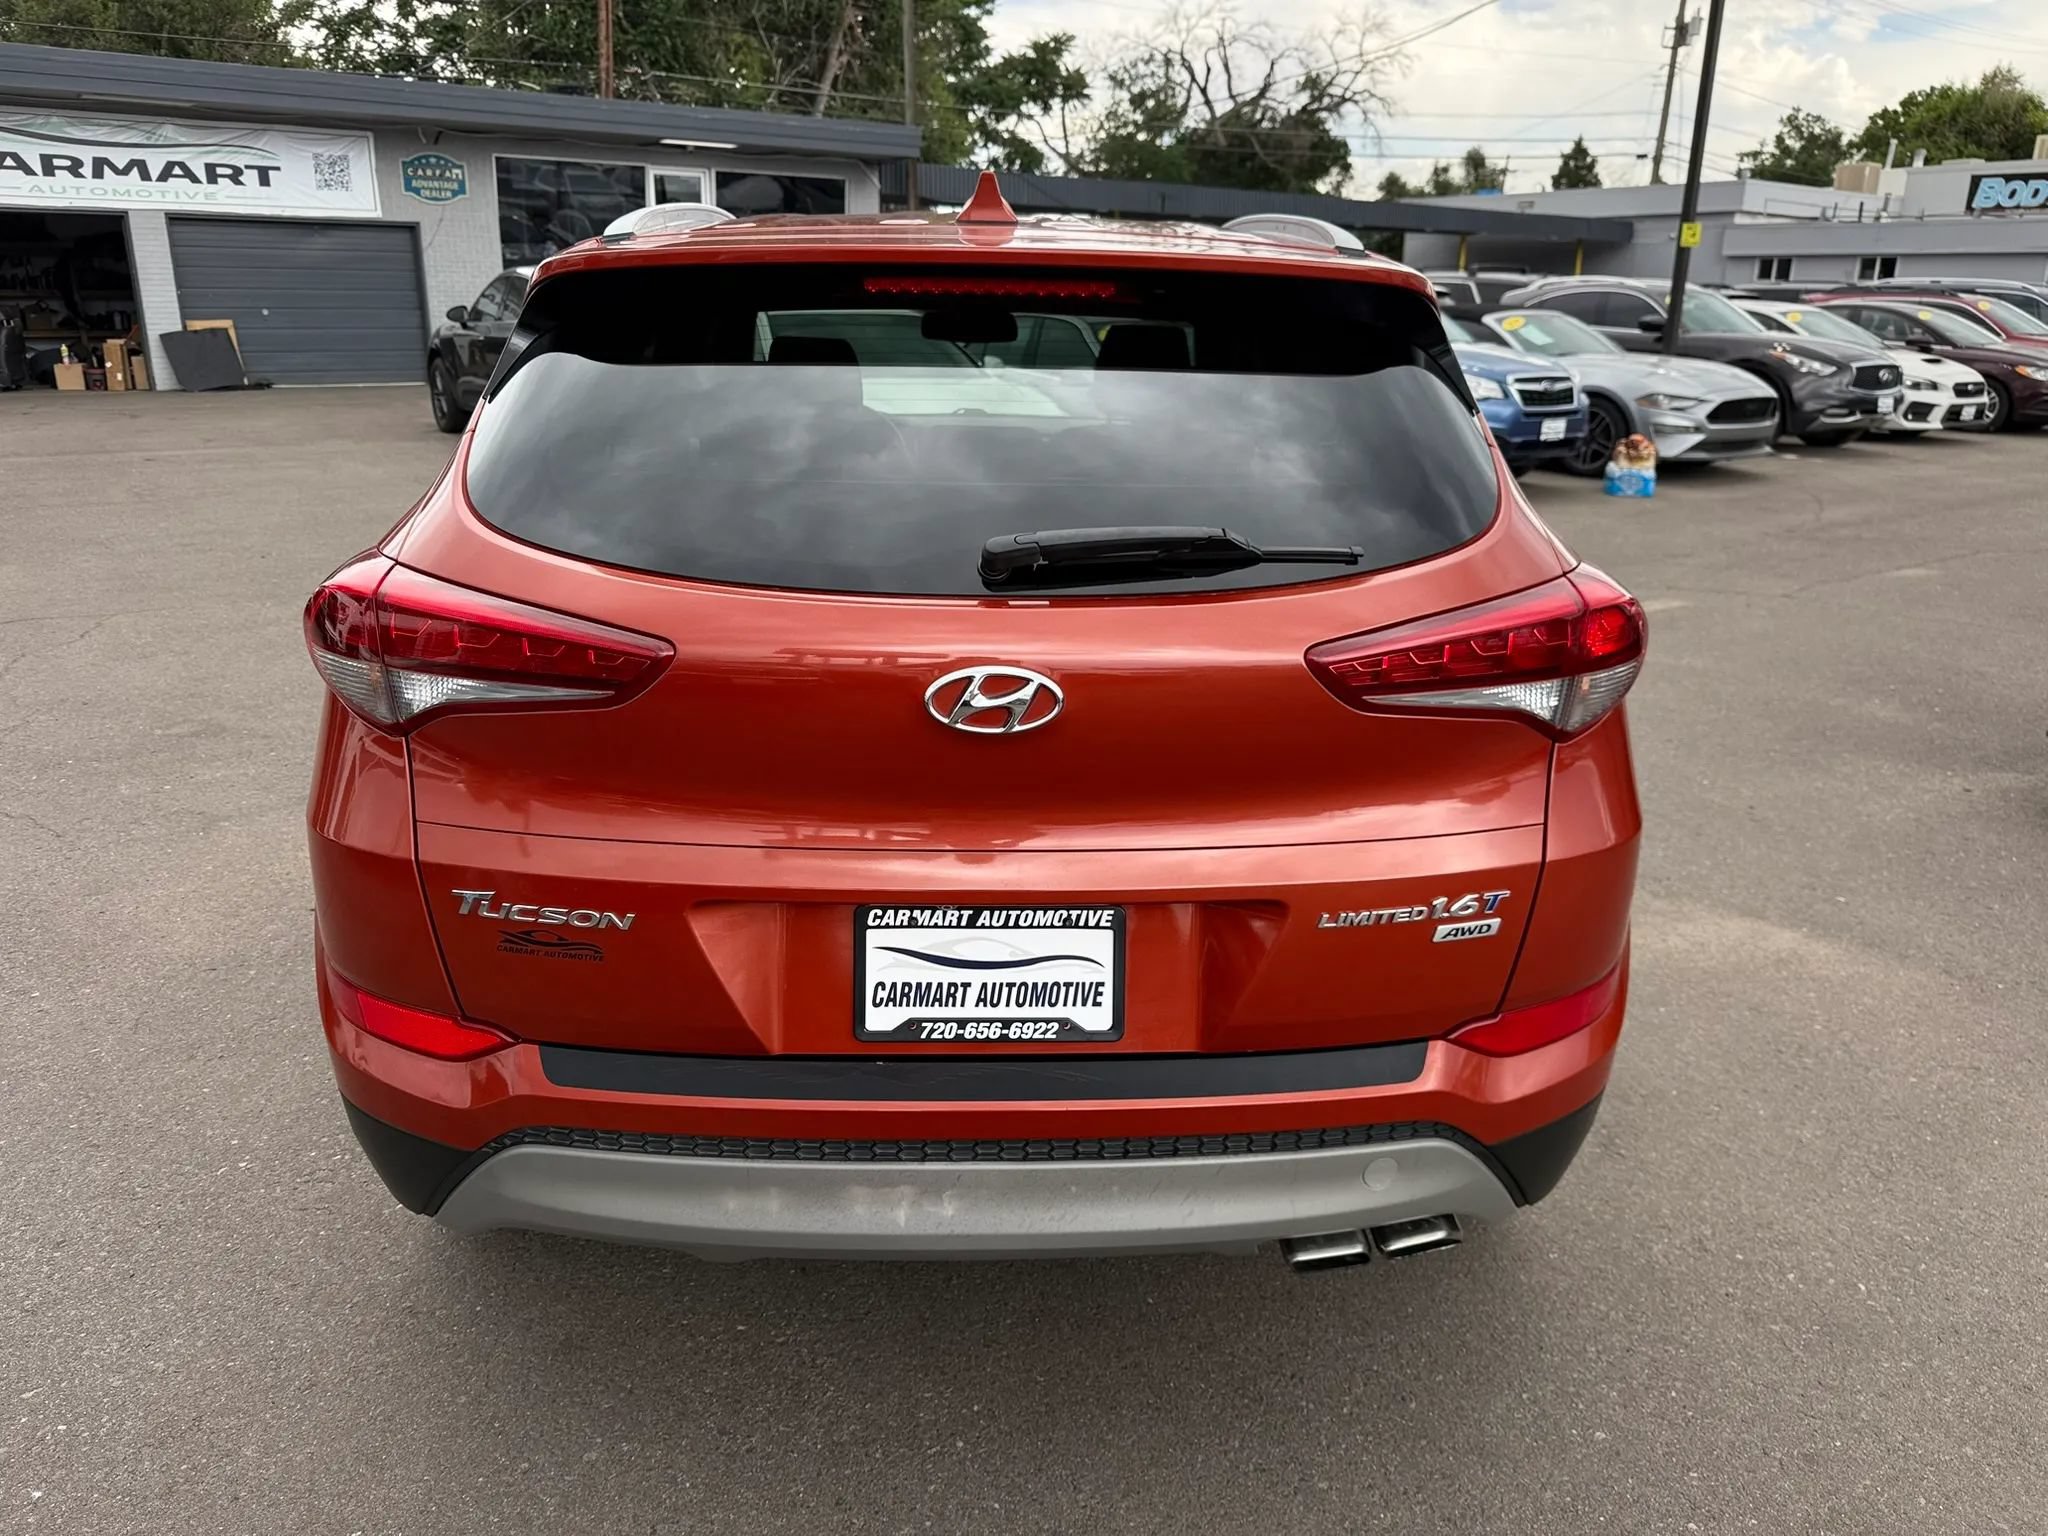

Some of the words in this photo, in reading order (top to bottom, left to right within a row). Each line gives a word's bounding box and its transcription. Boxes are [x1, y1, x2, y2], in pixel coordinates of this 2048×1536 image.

[0, 151, 281, 188] ARMART
[28, 184, 219, 201] AUTOMOTIVE
[1971, 177, 2048, 209] BOD
[868, 909, 973, 927] CARMART
[976, 909, 1115, 927] AUTOMOTIVE
[1318, 906, 1428, 929] LIMITED
[1441, 923, 1492, 940] AWD
[497, 944, 541, 957] CARMART
[544, 951, 604, 963] AUTOMOTIVE
[872, 981, 972, 1008] CARMART
[975, 981, 1105, 1008] AUTOMOTIVE
[920, 1022, 1059, 1039] 720-656-6922
